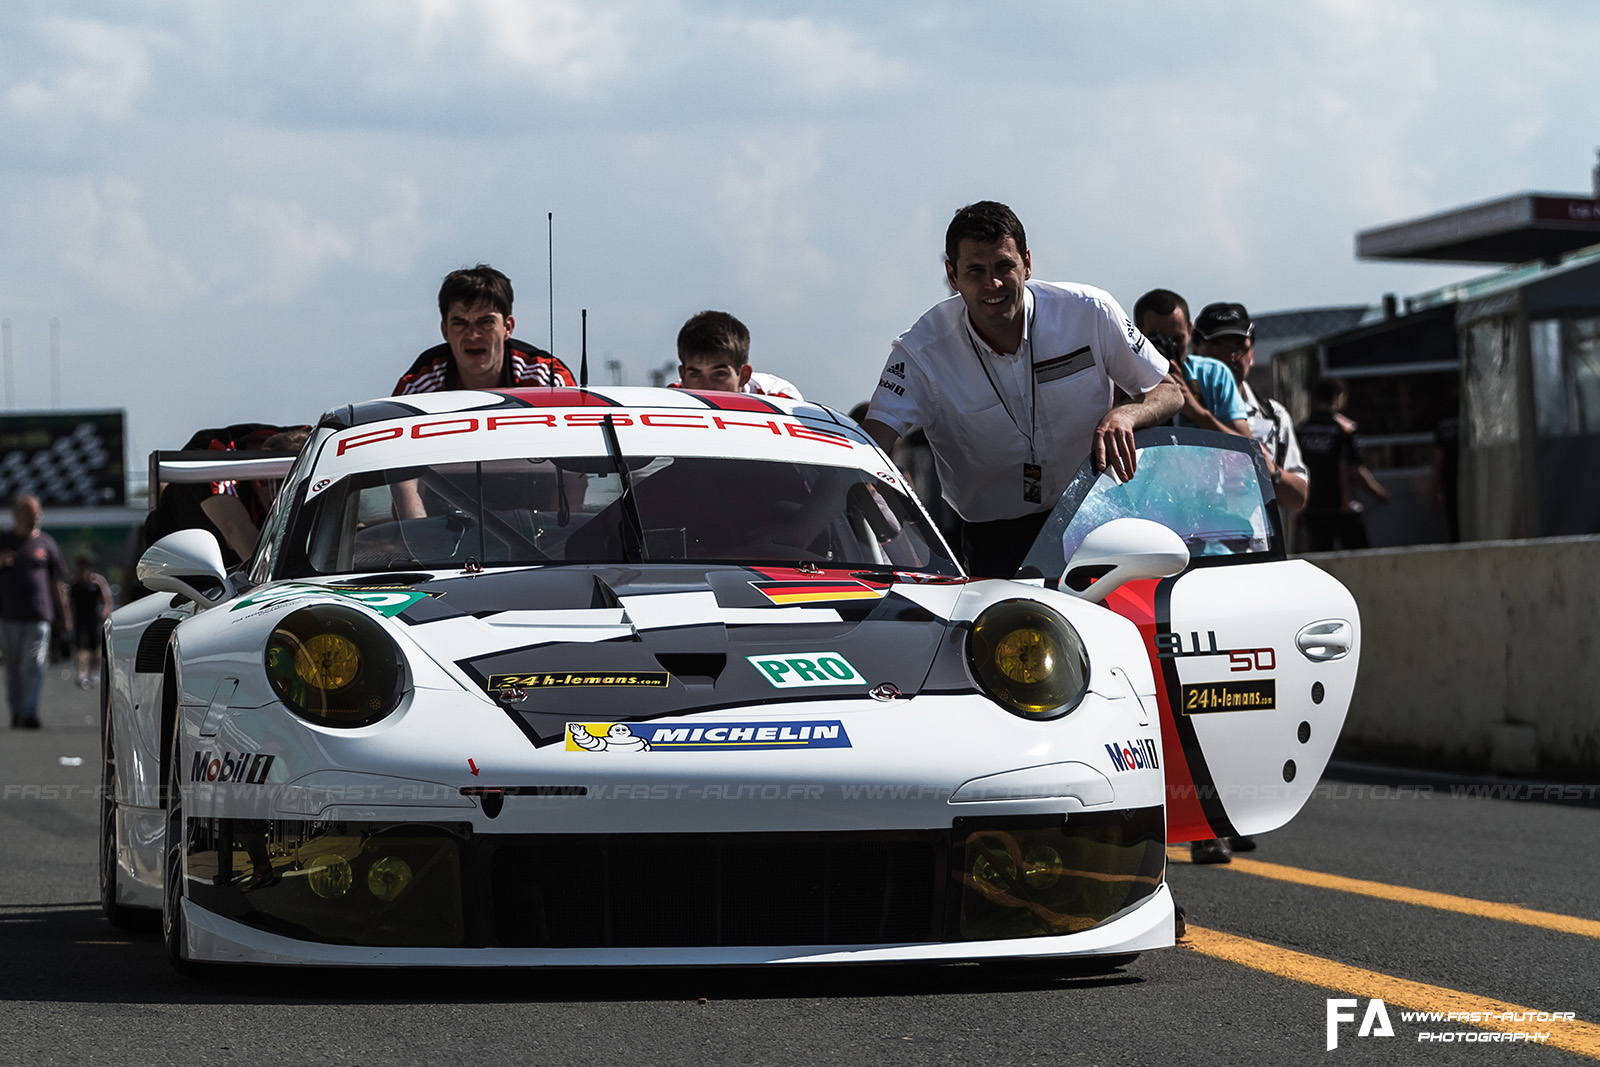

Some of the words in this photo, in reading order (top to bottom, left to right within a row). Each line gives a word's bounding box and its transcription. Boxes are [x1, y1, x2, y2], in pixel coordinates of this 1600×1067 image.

[336, 413, 854, 457] PORSCHE
[756, 656, 857, 683] PRO
[1229, 647, 1277, 672] 50
[651, 725, 840, 743] MICHELIN
[191, 751, 251, 783] Mobil
[1104, 739, 1151, 773] Mobil
